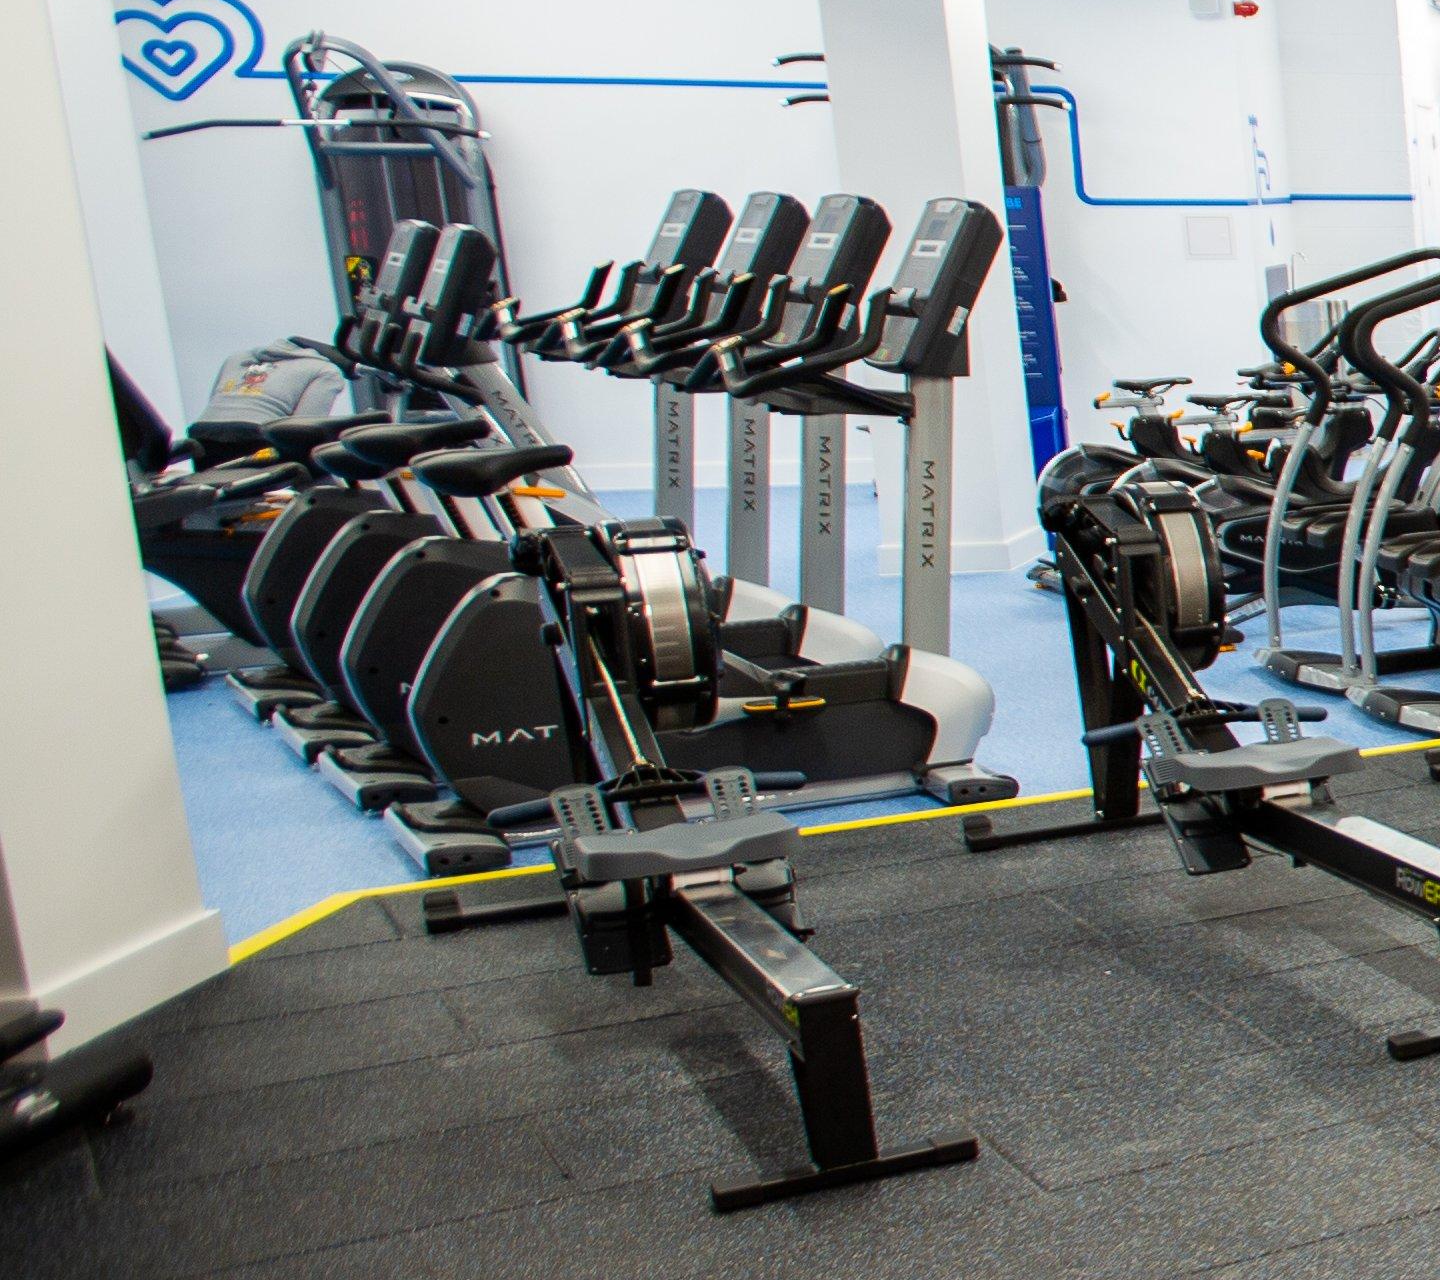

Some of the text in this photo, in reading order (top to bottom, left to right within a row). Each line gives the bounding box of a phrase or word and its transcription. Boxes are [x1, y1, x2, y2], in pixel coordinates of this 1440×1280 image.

[668, 401, 681, 489] MATRIX
[743, 419, 756, 512] MATRIX
[819, 436, 832, 535] MATRIX
[922, 460, 935, 568] MATRIX
